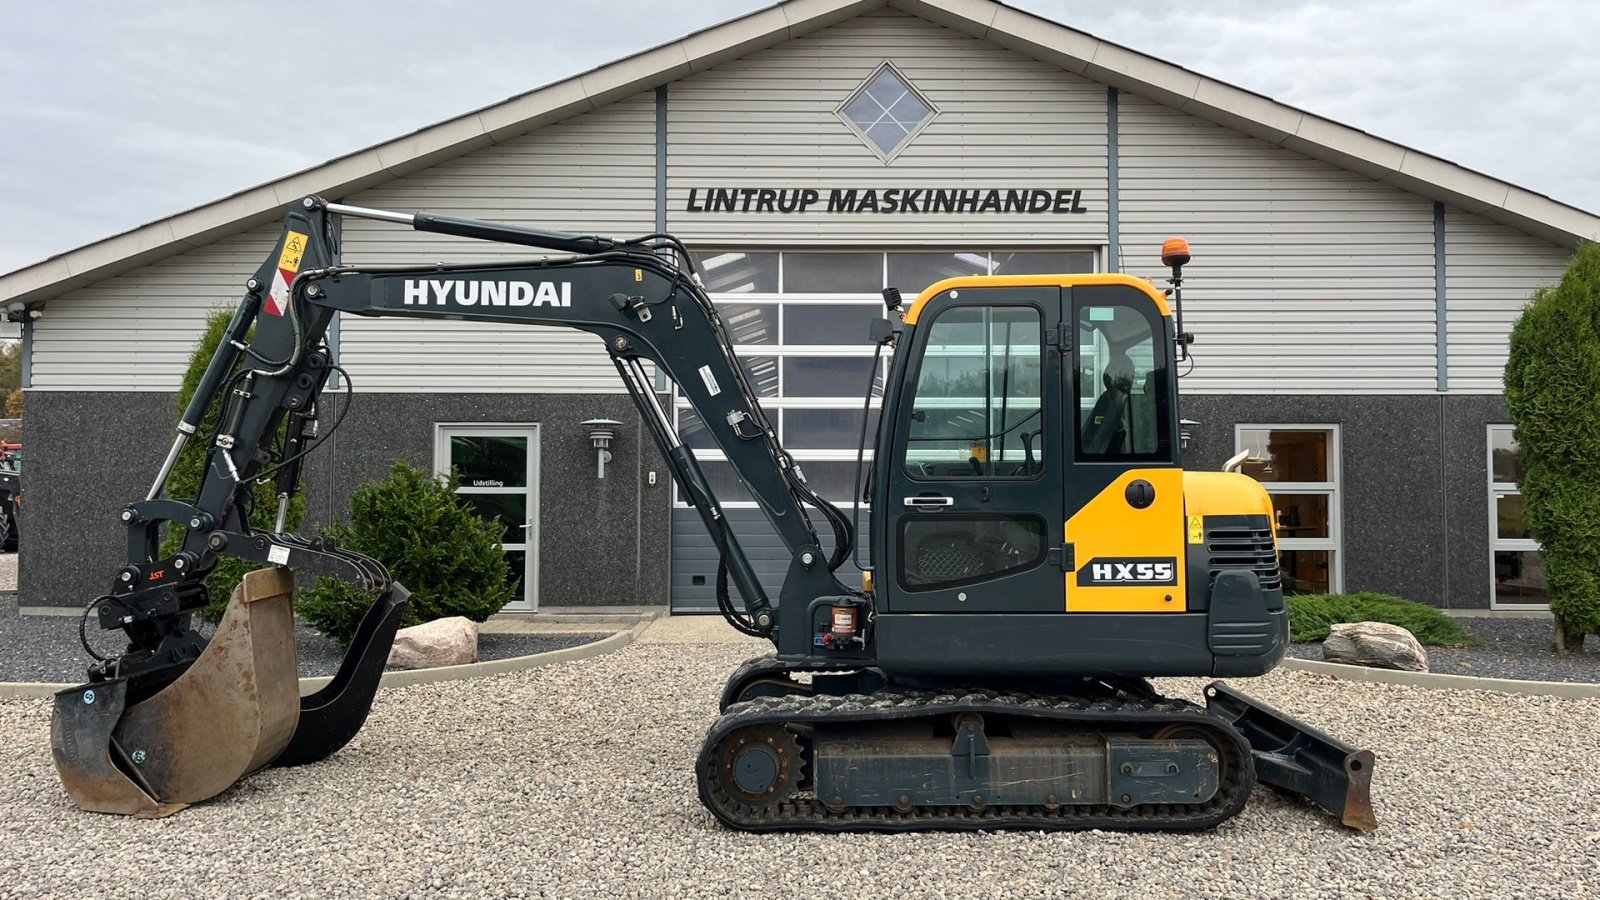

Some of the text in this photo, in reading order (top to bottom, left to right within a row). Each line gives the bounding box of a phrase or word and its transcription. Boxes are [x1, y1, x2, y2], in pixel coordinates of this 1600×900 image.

[686, 188, 1087, 214] LINTRUP MASKINHANDEL
[403, 279, 572, 307] HYUNDAI
[473, 479, 504, 488] Udstilling
[1092, 562, 1172, 581] HX55
